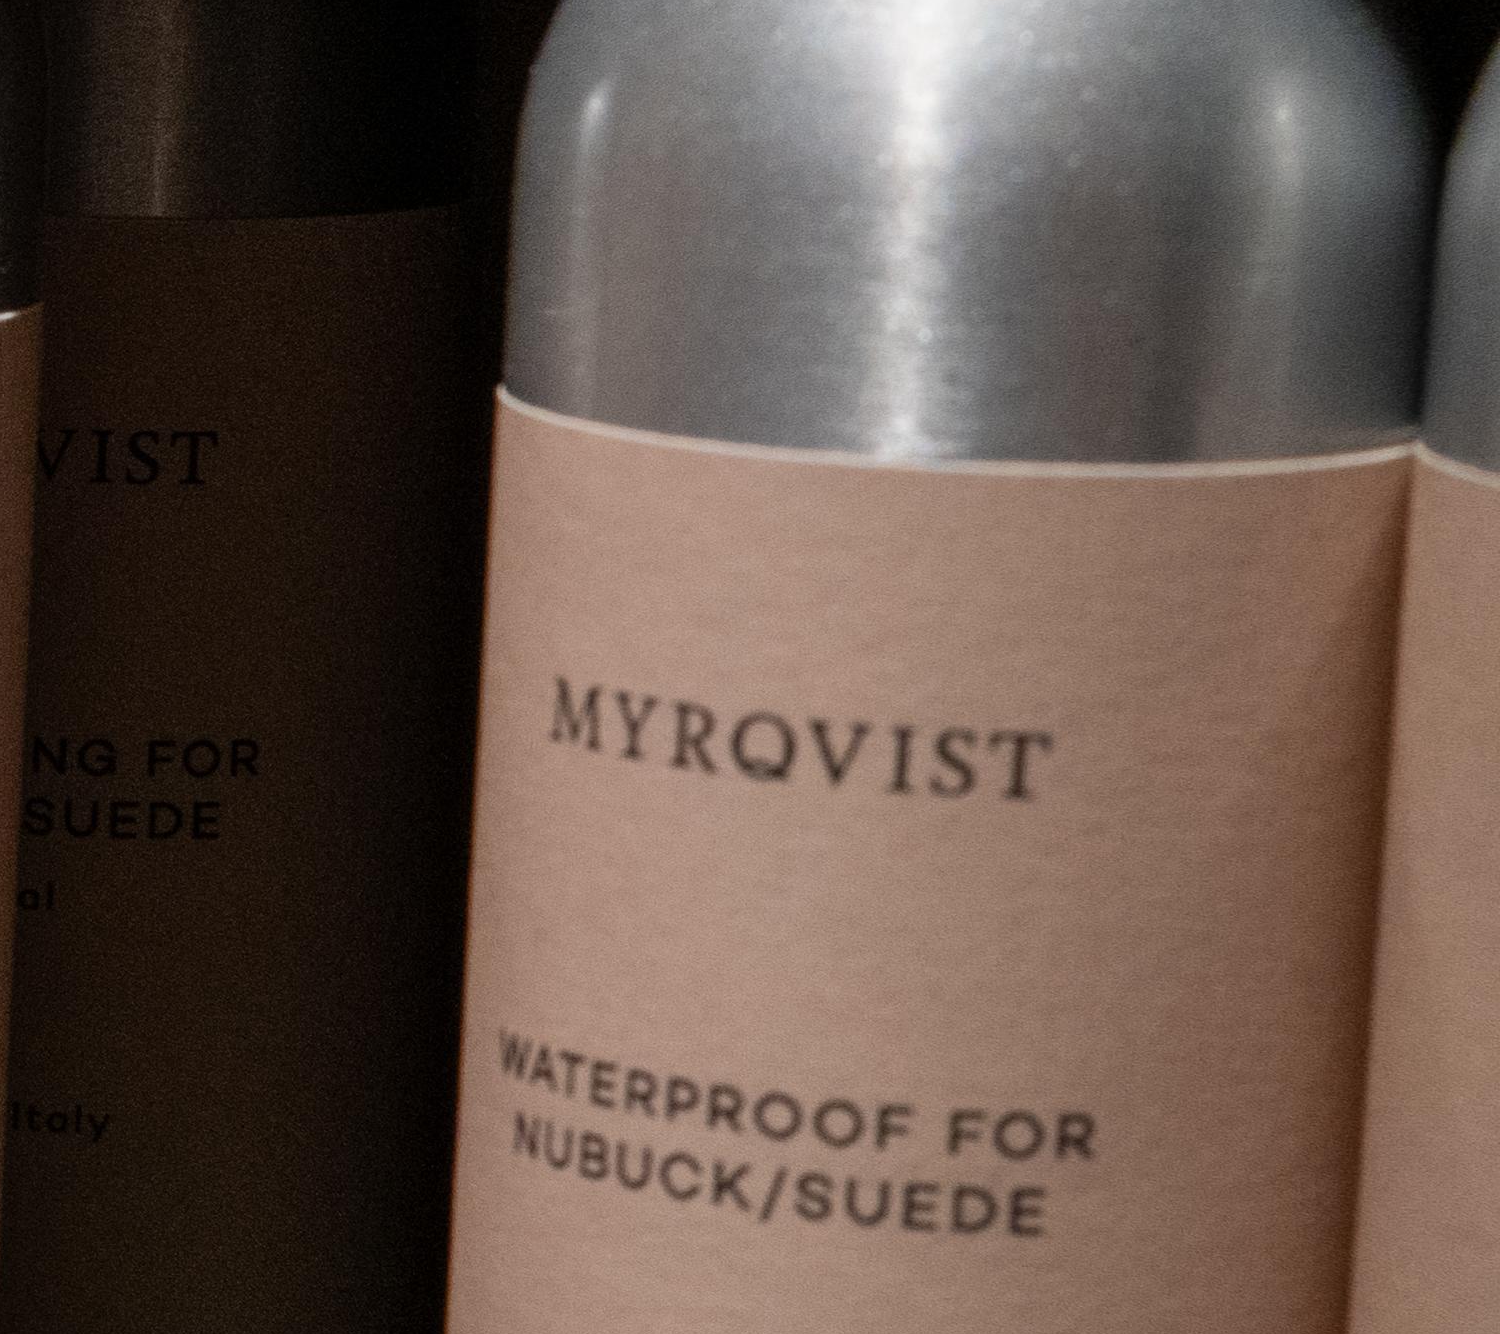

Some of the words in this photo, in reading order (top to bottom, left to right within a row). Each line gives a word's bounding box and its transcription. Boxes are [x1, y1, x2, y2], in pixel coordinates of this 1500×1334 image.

[38, 427, 220, 487] VIST
[146, 736, 261, 780] FOR
[547, 674, 1054, 802] MYRQVIST
[499, 1028, 918, 1152] WATERPROOF
[946, 1107, 1098, 1161] FOR
[512, 1109, 1049, 1239] NUBUCK/SUEDE
